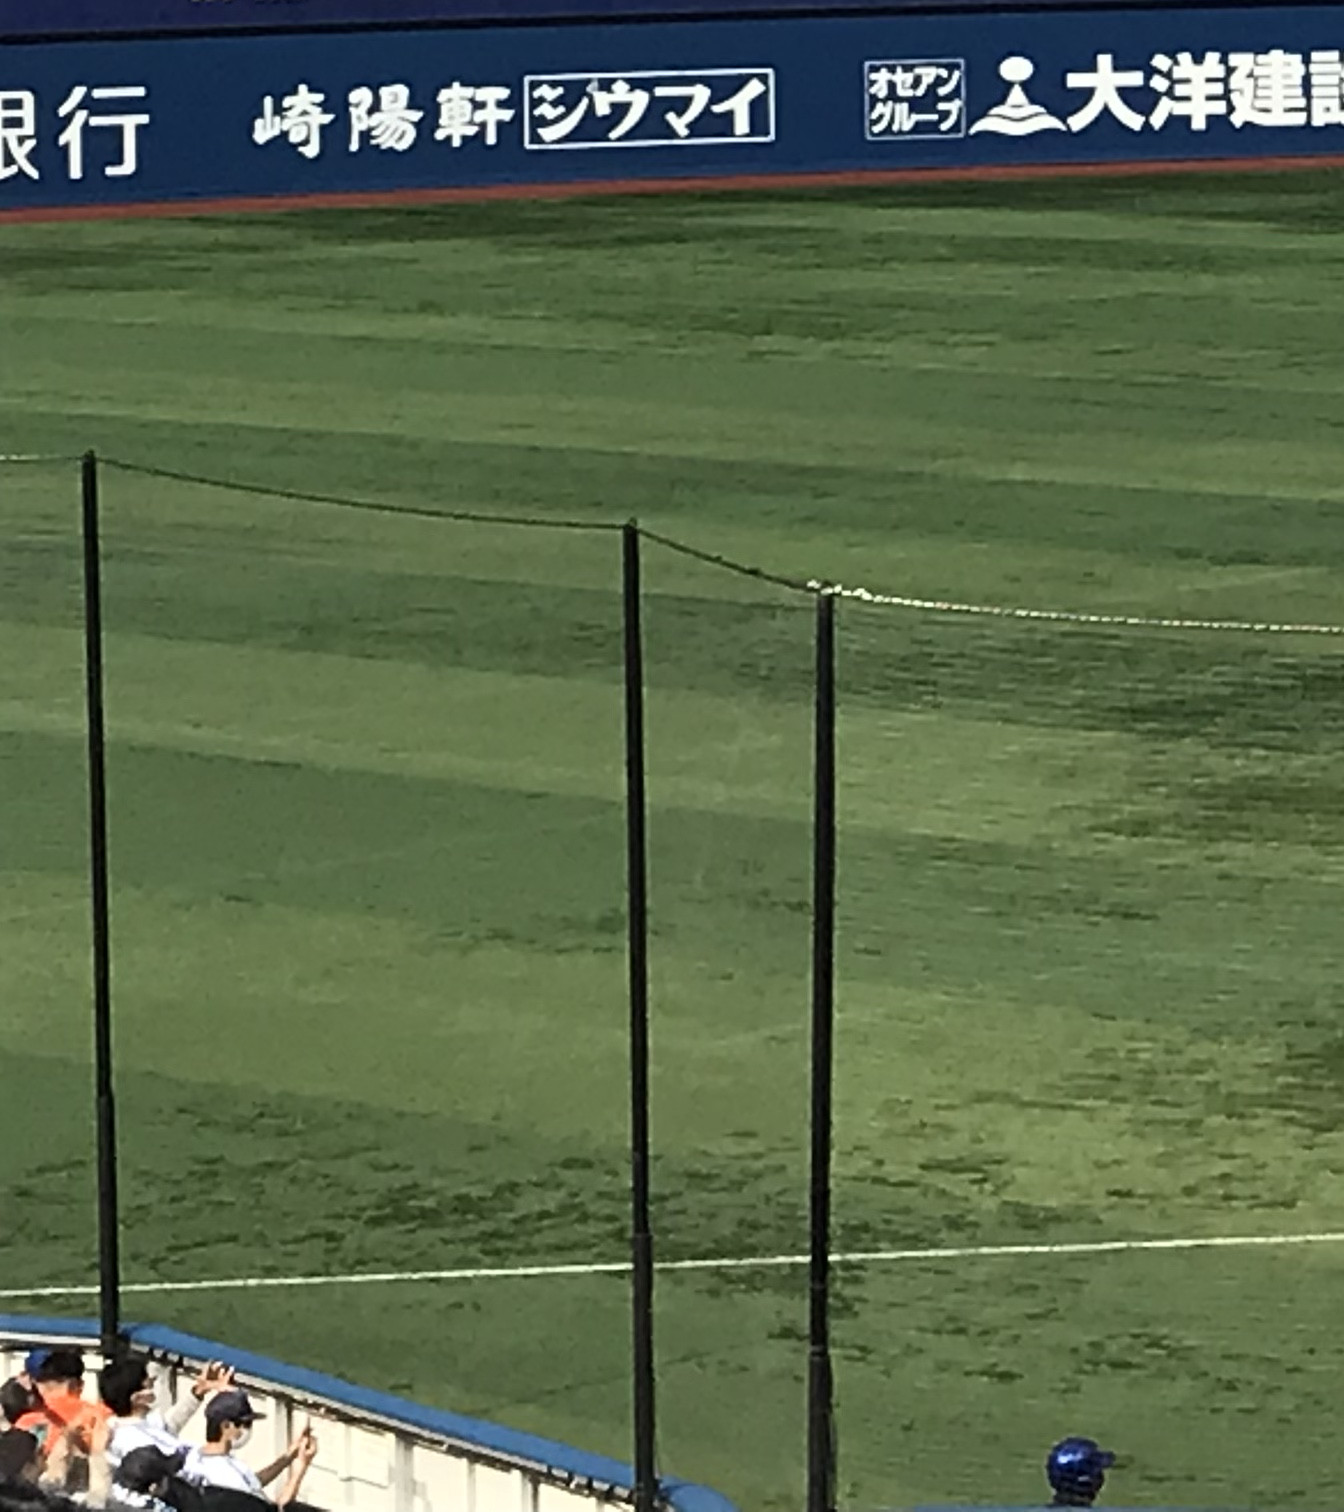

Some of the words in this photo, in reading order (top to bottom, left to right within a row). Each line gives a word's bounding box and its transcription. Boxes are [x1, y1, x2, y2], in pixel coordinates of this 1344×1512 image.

[868, 67, 961, 99] オセアン
[252, 82, 515, 159] 崎陽軒
[532, 77, 768, 144] シウマイ
[869, 99, 962, 133] グループ
